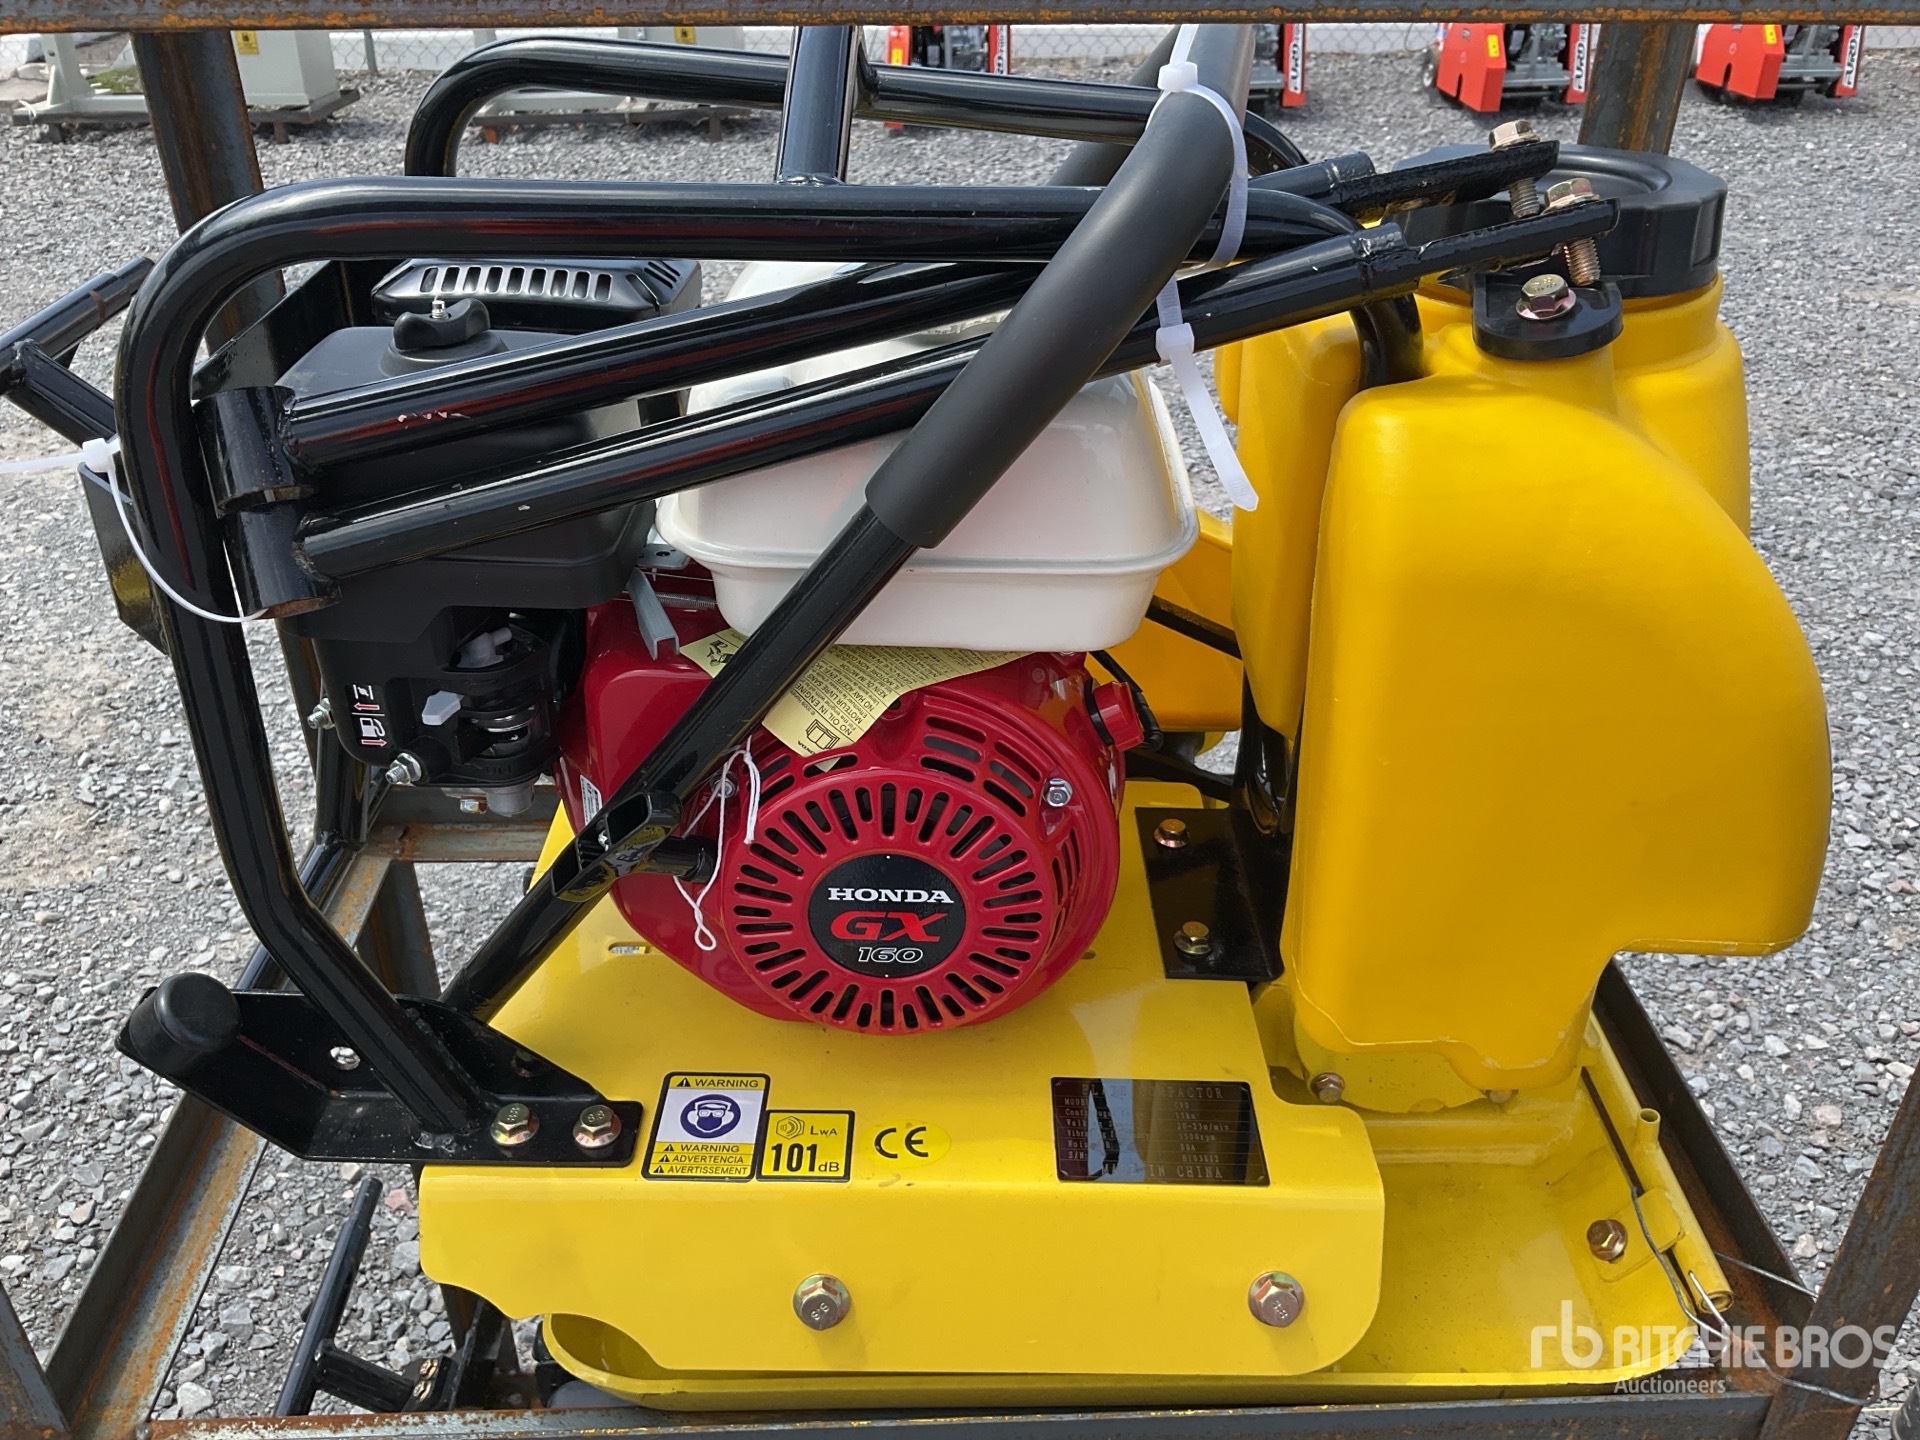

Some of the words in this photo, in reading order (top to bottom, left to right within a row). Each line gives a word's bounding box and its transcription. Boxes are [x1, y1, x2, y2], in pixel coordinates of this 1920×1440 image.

[807, 673, 823, 686] SANS
[794, 682, 819, 706] ENGINE
[820, 685, 837, 700] LIVRE
[852, 690, 865, 702] HAY
[818, 705, 827, 714] IN
[836, 698, 862, 723] MOTEUR
[863, 701, 874, 711] NO
[827, 713, 839, 725] OIL
[839, 724, 851, 735] NO
[828, 887, 954, 904] HONDA
[830, 910, 948, 942] GX
[858, 946, 923, 964] 160
[694, 1078, 759, 1088] WARNING
[680, 1143, 740, 1153] WARNING
[874, 1126, 929, 1158] CE
[672, 1154, 744, 1164] ADVERTENCIA
[771, 1142, 818, 1173] 101
[818, 1160, 840, 1172] dB
[667, 1165, 748, 1175] AVERTISSEMENT
[1149, 1164, 1166, 1177] IN
[1176, 1166, 1223, 1178] CHINA
